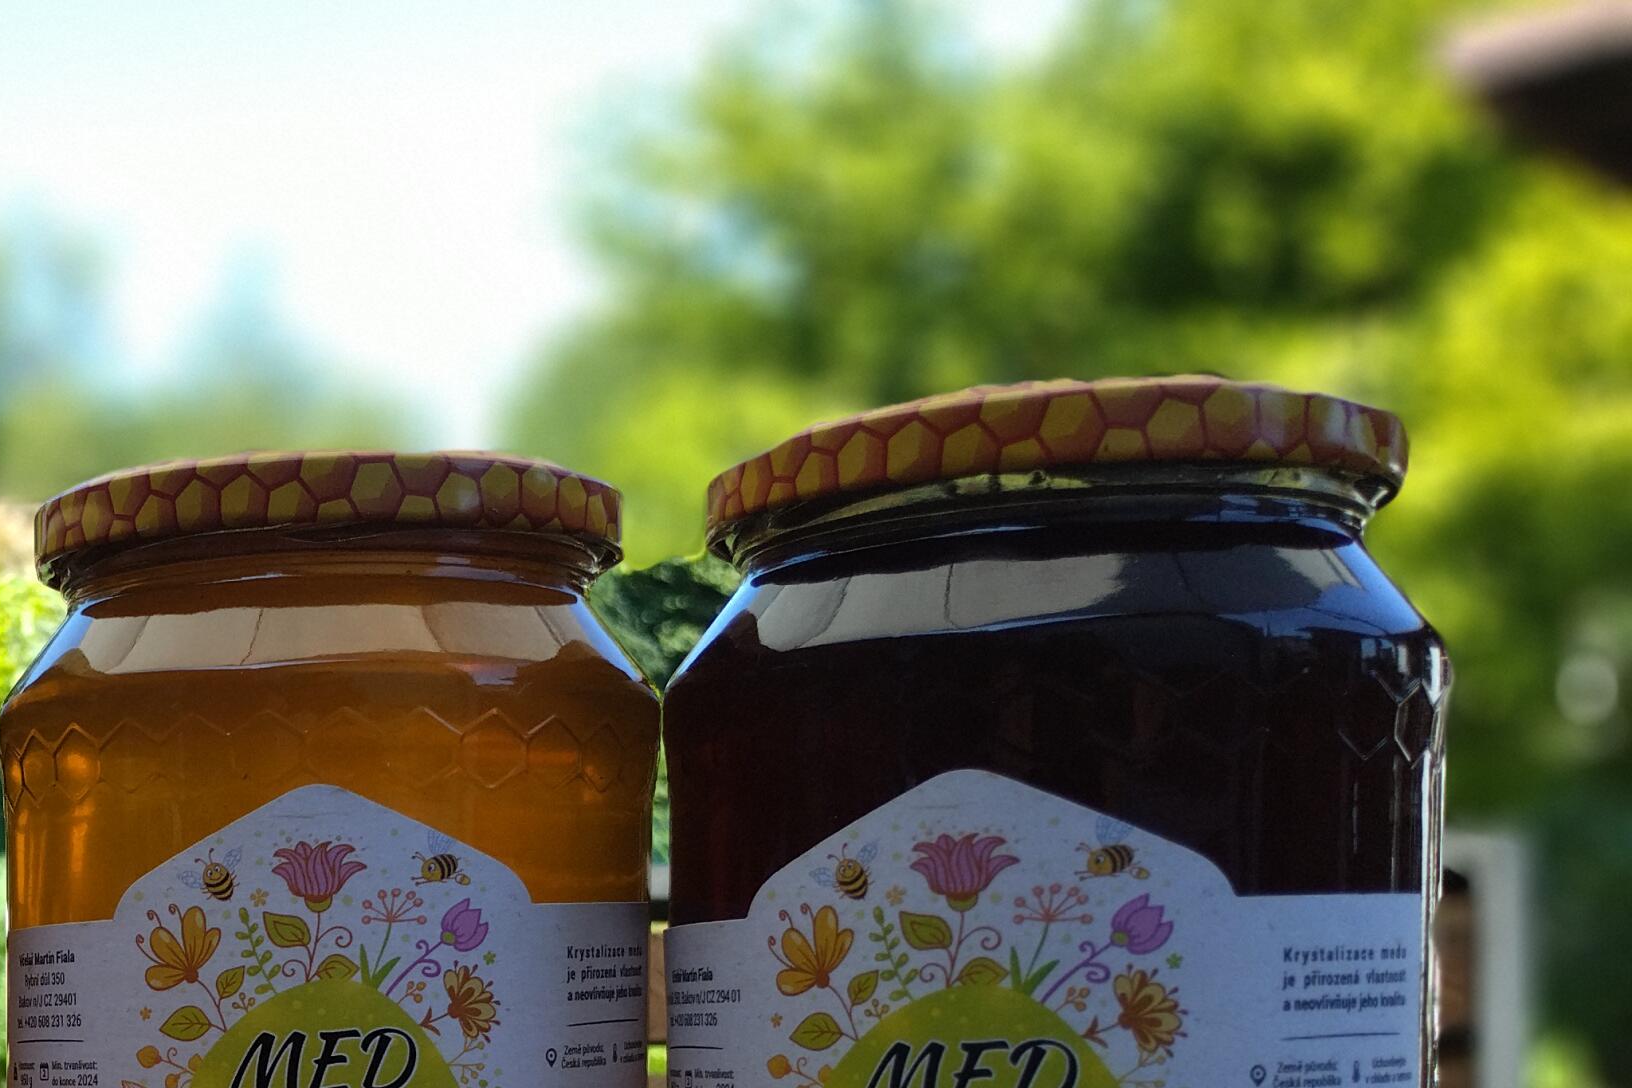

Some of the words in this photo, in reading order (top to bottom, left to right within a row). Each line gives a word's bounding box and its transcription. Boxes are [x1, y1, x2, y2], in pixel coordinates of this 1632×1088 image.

[56, 949, 75, 964] Fiala
[567, 944, 625, 961] Krystalizace
[1283, 945, 1375, 965] Krystalizace
[51, 972, 65, 985] 350
[566, 967, 575, 984] je
[1282, 972, 1295, 990] je
[1303, 969, 1360, 989] přirozená
[43, 994, 52, 1007] CZ
[54, 993, 77, 1007] 29401
[567, 991, 573, 1001] a
[1283, 1000, 1290, 1011] a
[51, 1015, 64, 1028] 231
[66, 1014, 82, 1028] 326
[704, 1012, 718, 1026] 326
[77, 1074, 98, 1086] 2024
